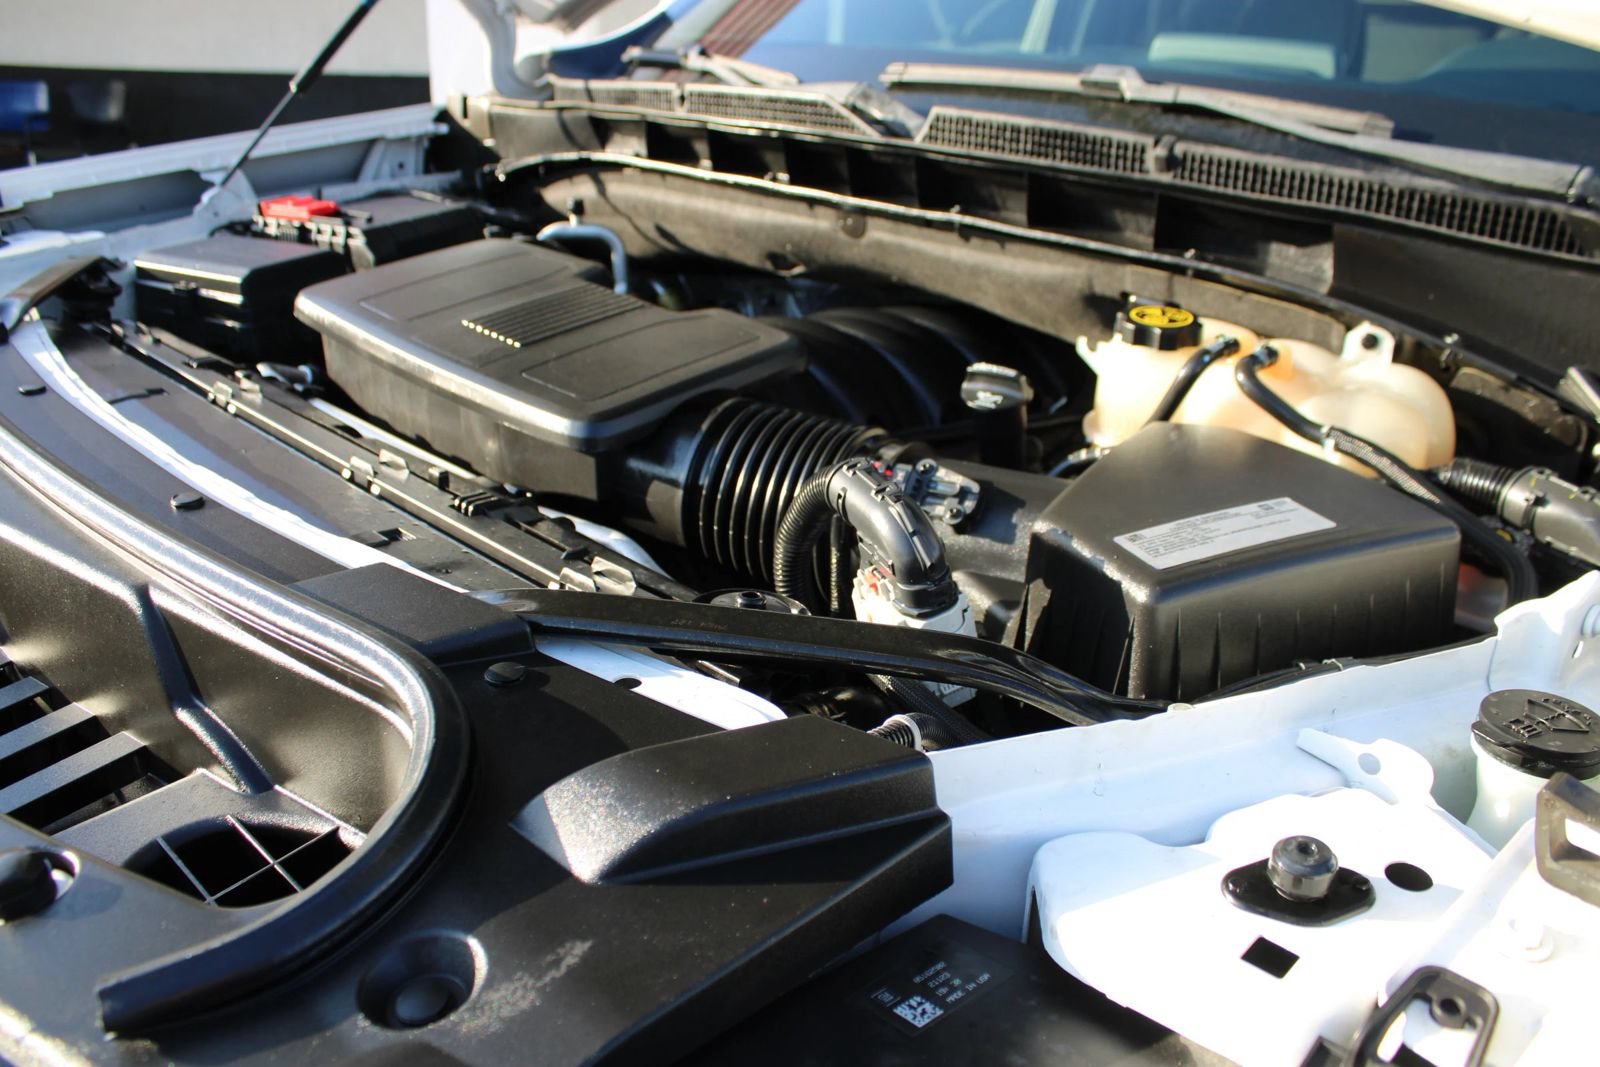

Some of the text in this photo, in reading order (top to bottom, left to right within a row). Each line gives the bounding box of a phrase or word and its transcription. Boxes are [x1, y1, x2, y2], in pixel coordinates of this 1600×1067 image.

[946, 973, 991, 1003] MADE IN USA
